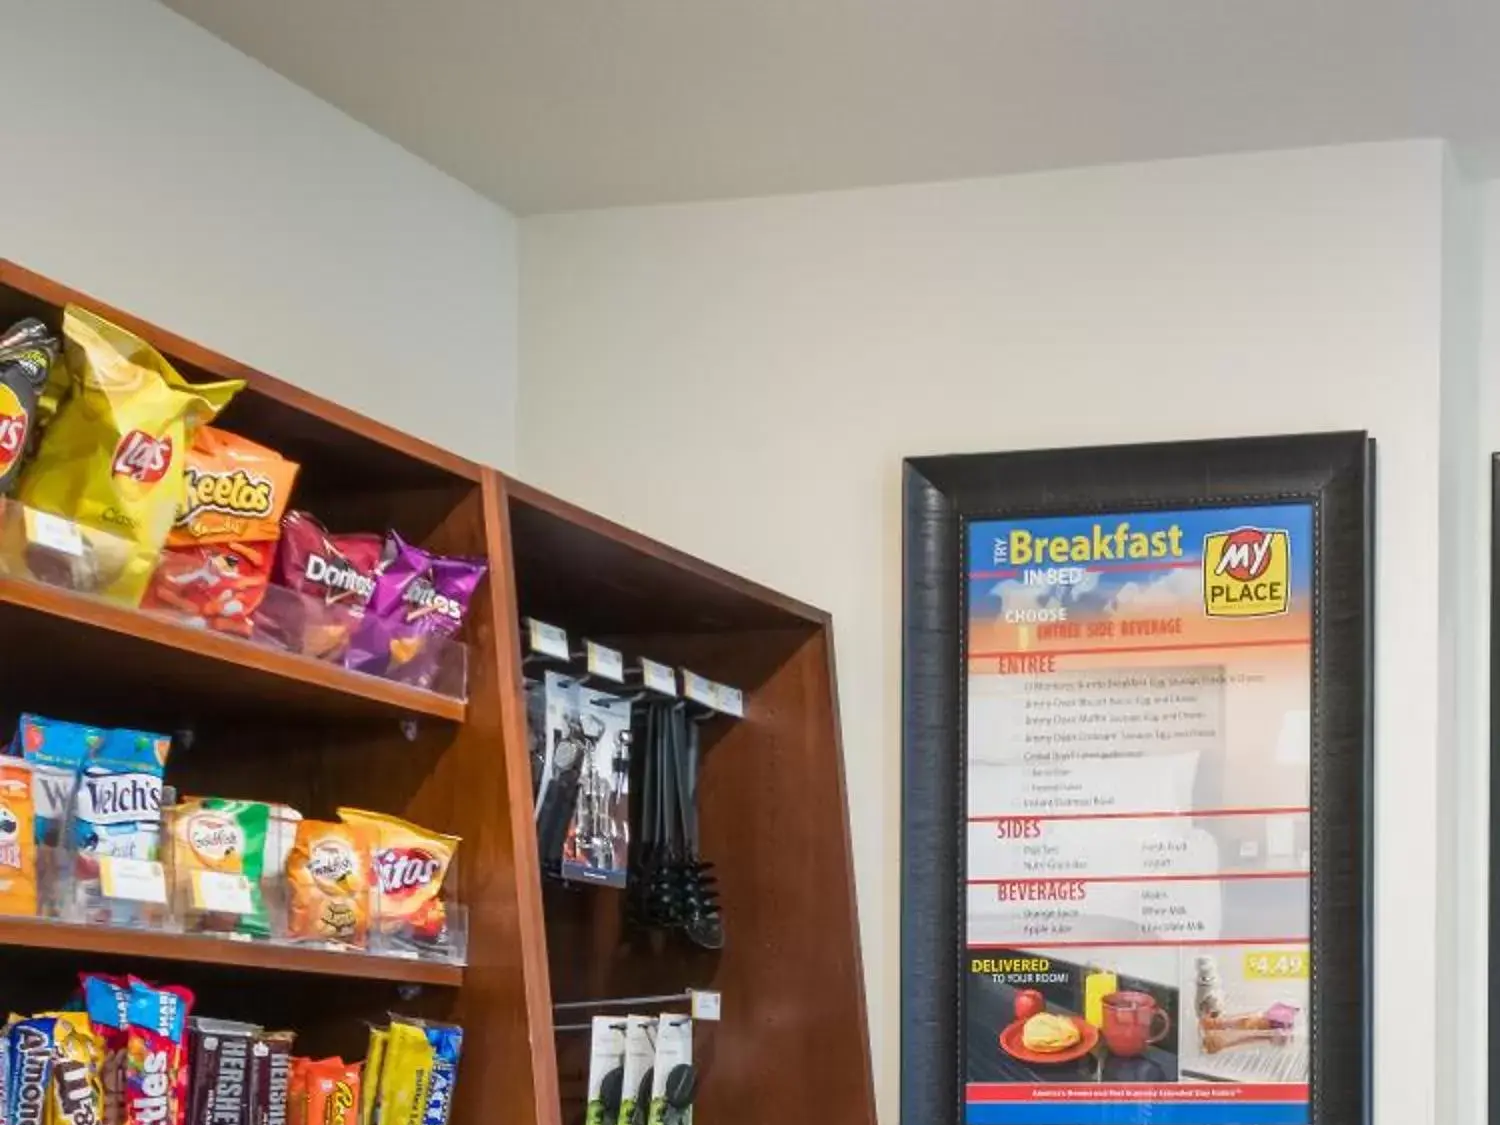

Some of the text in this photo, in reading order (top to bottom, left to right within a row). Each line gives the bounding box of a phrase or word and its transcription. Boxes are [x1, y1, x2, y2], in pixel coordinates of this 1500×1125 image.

[993, 538, 1008, 567] TRY
[1009, 522, 1184, 566] Breakfast
[1215, 532, 1273, 576] MY
[305, 554, 377, 597] Doritos
[1023, 569, 1043, 586] IN
[1210, 581, 1282, 603] PLACE
[1005, 608, 1068, 623] CHOOSE
[1086, 621, 1114, 638] SIDE
[1120, 617, 1183, 636] BEVERAGE
[998, 654, 1057, 675] ENTREE
[87, 778, 162, 815] Welch's
[997, 818, 1041, 839] SIDES
[997, 881, 1086, 901] BEVERAGES
[971, 958, 1049, 974] DELIVERED
[991, 973, 1005, 984] TO
[1007, 973, 1034, 984] YOUR
